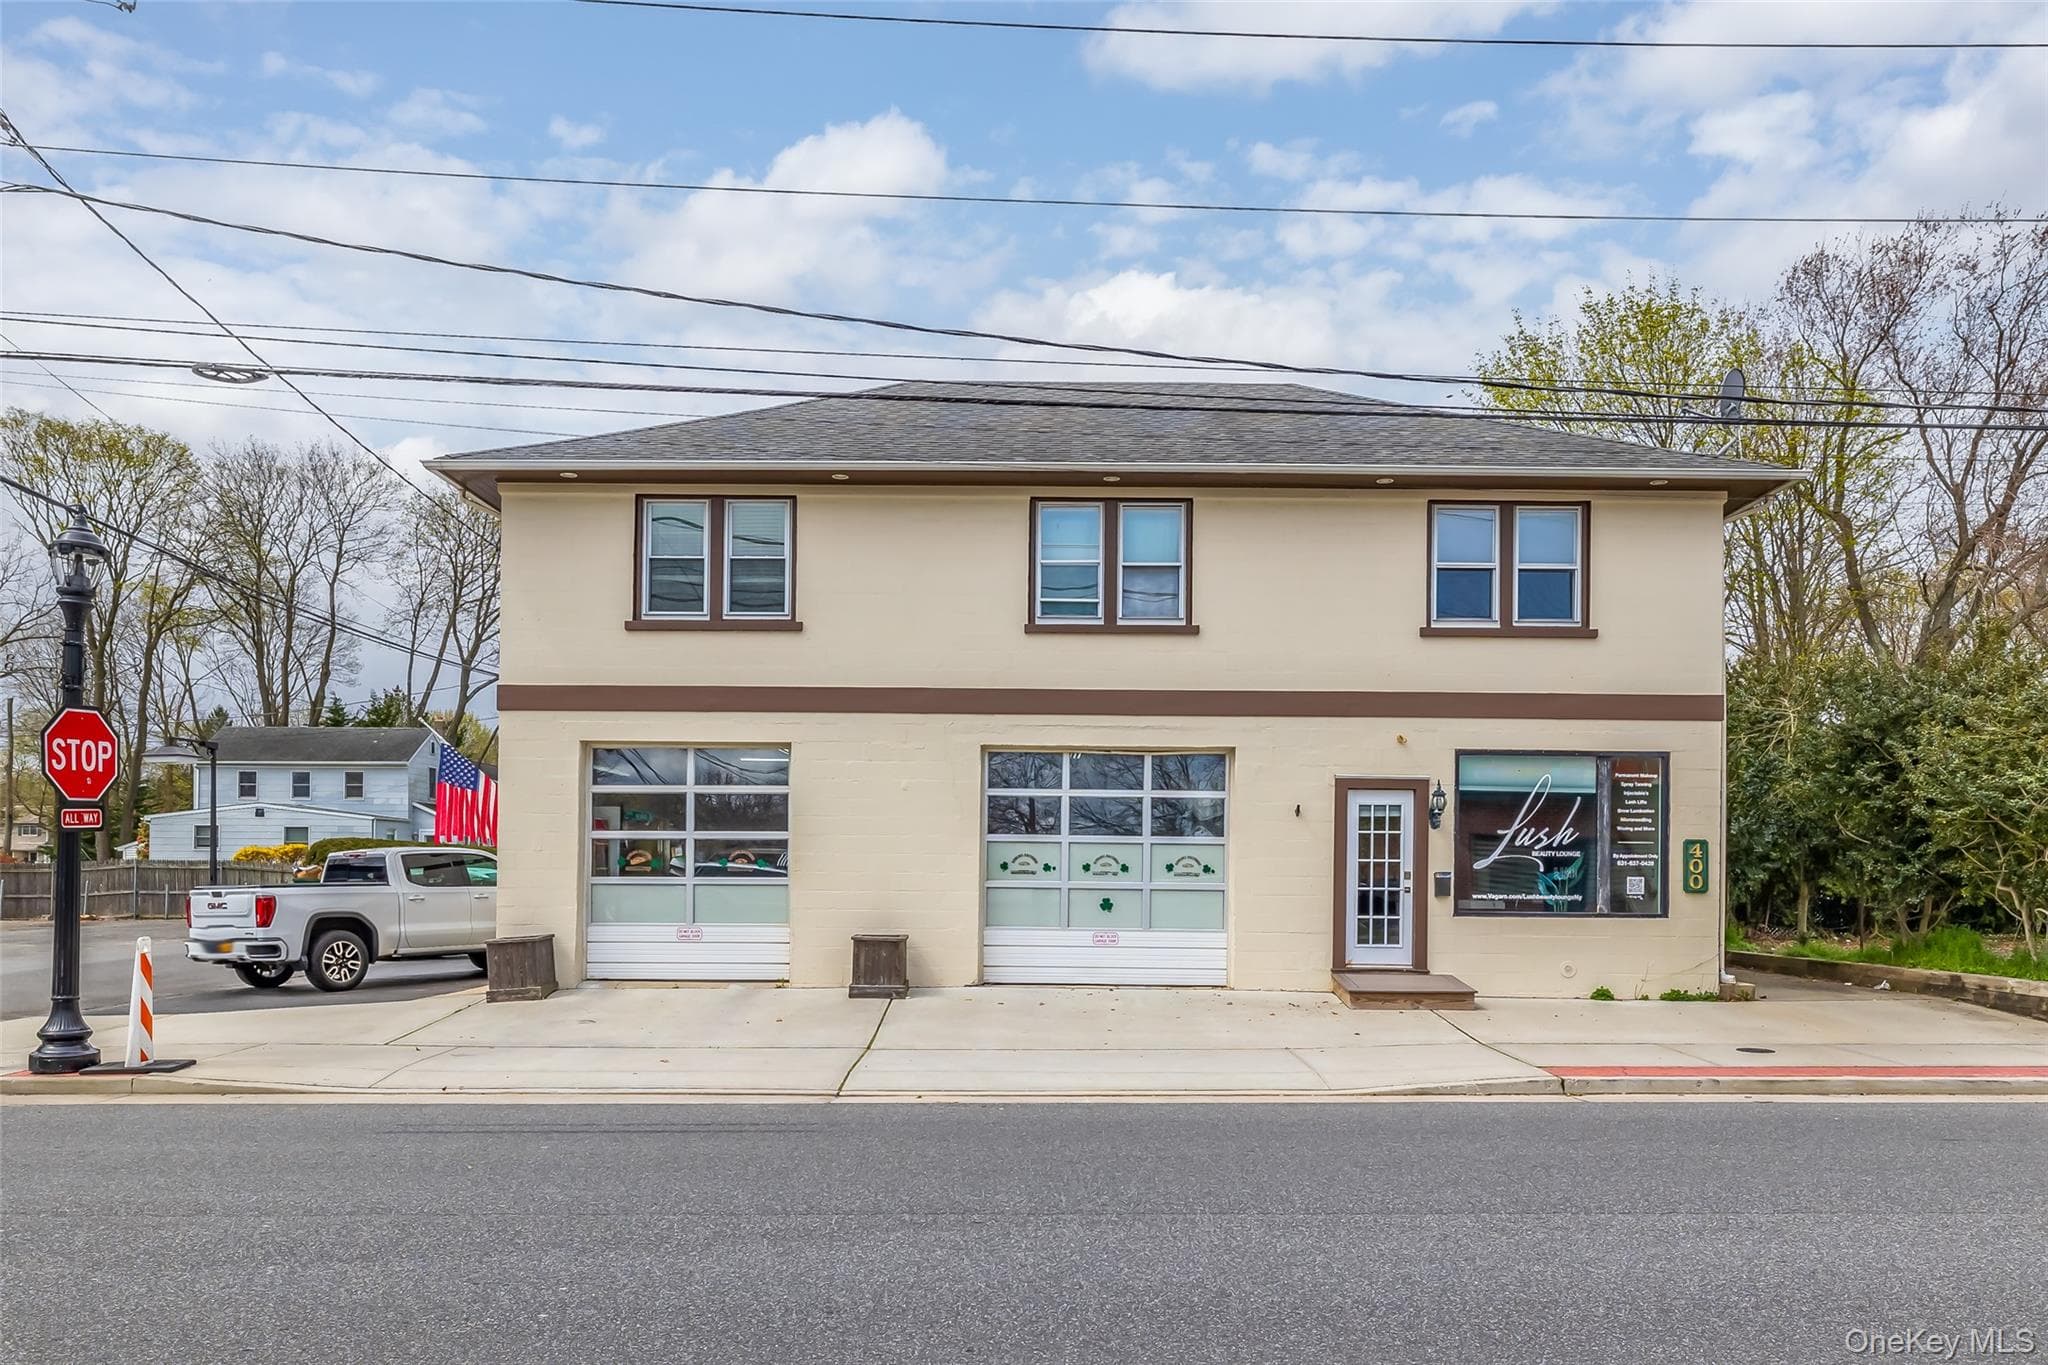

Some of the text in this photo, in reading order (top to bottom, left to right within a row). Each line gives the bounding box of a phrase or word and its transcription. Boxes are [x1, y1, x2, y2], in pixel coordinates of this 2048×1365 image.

[51, 737, 113, 772] STOP
[64, 812, 99, 824] ALL WAY
[1473, 774, 1581, 872] Lush
[1688, 843, 1704, 889] 400
[207, 902, 228, 910] GMC
